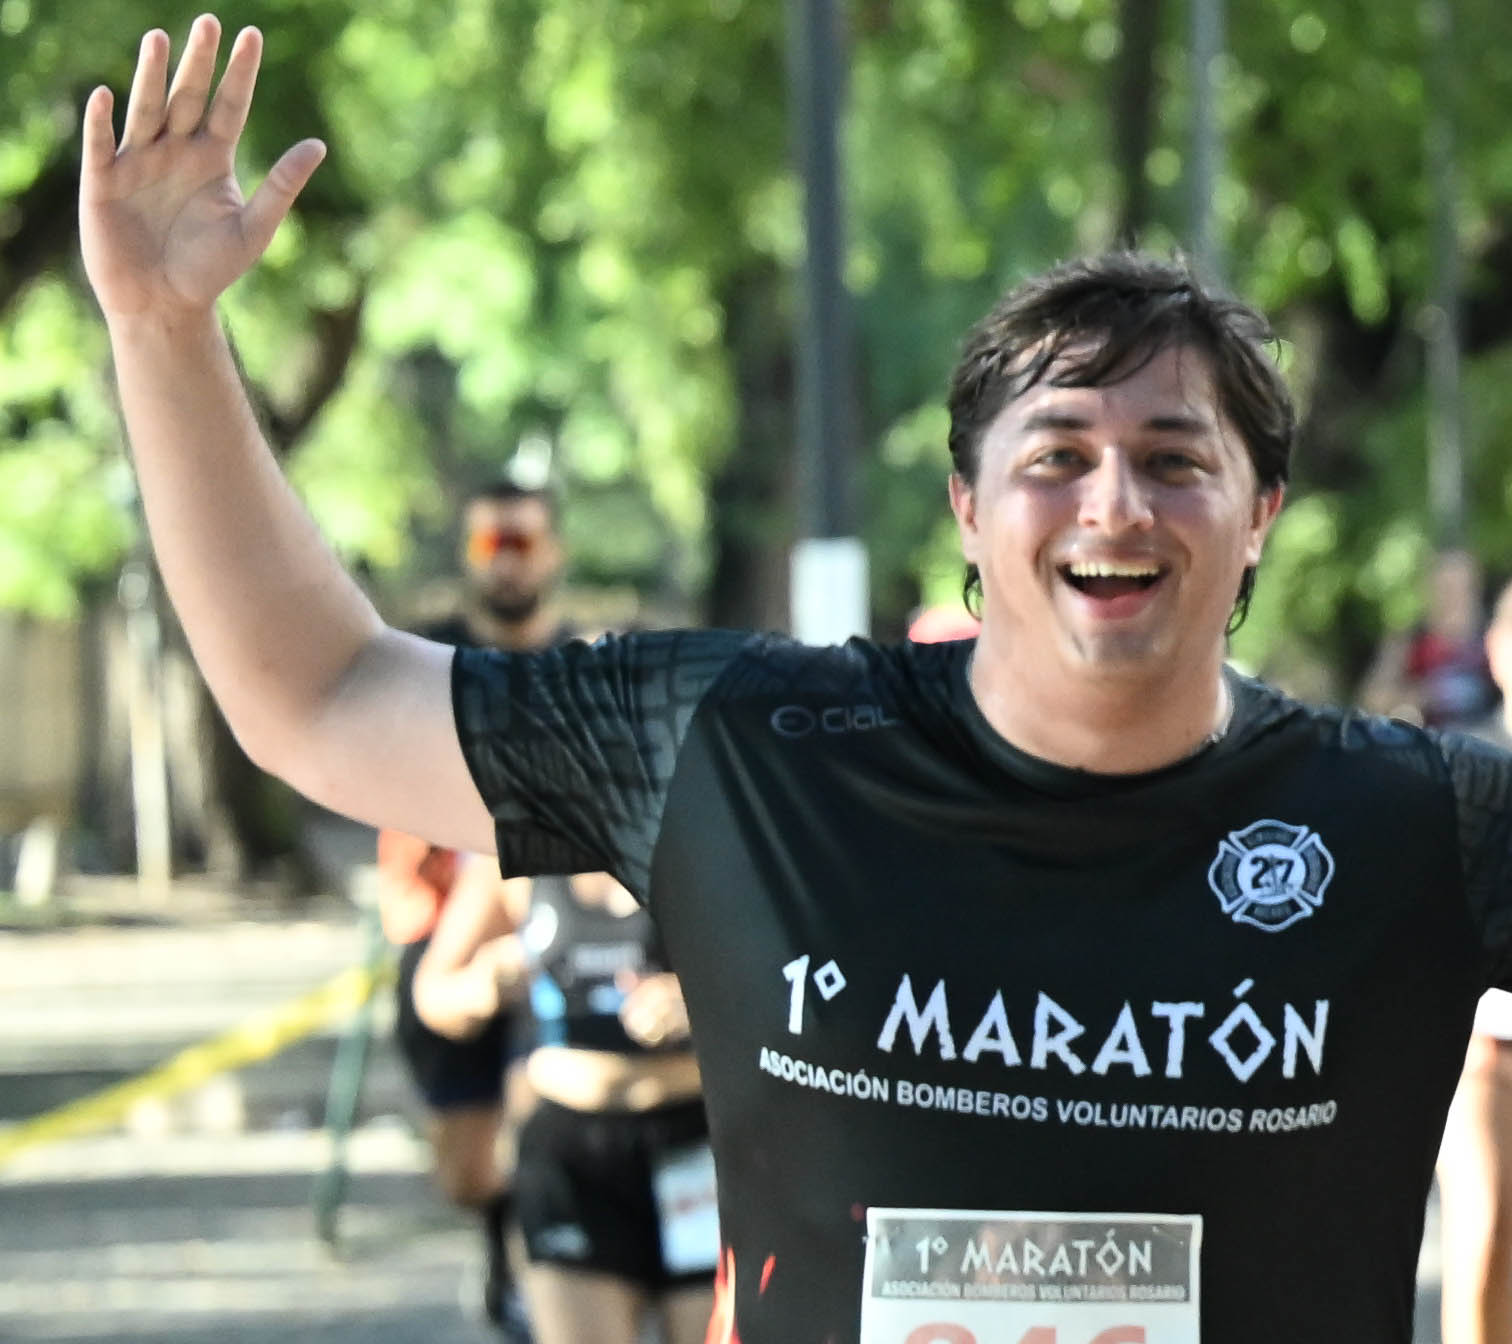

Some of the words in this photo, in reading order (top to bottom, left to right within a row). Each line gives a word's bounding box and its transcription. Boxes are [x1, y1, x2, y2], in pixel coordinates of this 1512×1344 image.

[877, 972, 1330, 1084] MARATÓN
[759, 1046, 890, 1102] ASOCIACIÓN
[897, 1080, 1048, 1123] BOMBEROS
[1056, 1098, 1243, 1133] VOLUNTARIOS
[1249, 1099, 1338, 1133] ROSARIO
[960, 1227, 1153, 1278] MARATÓN
